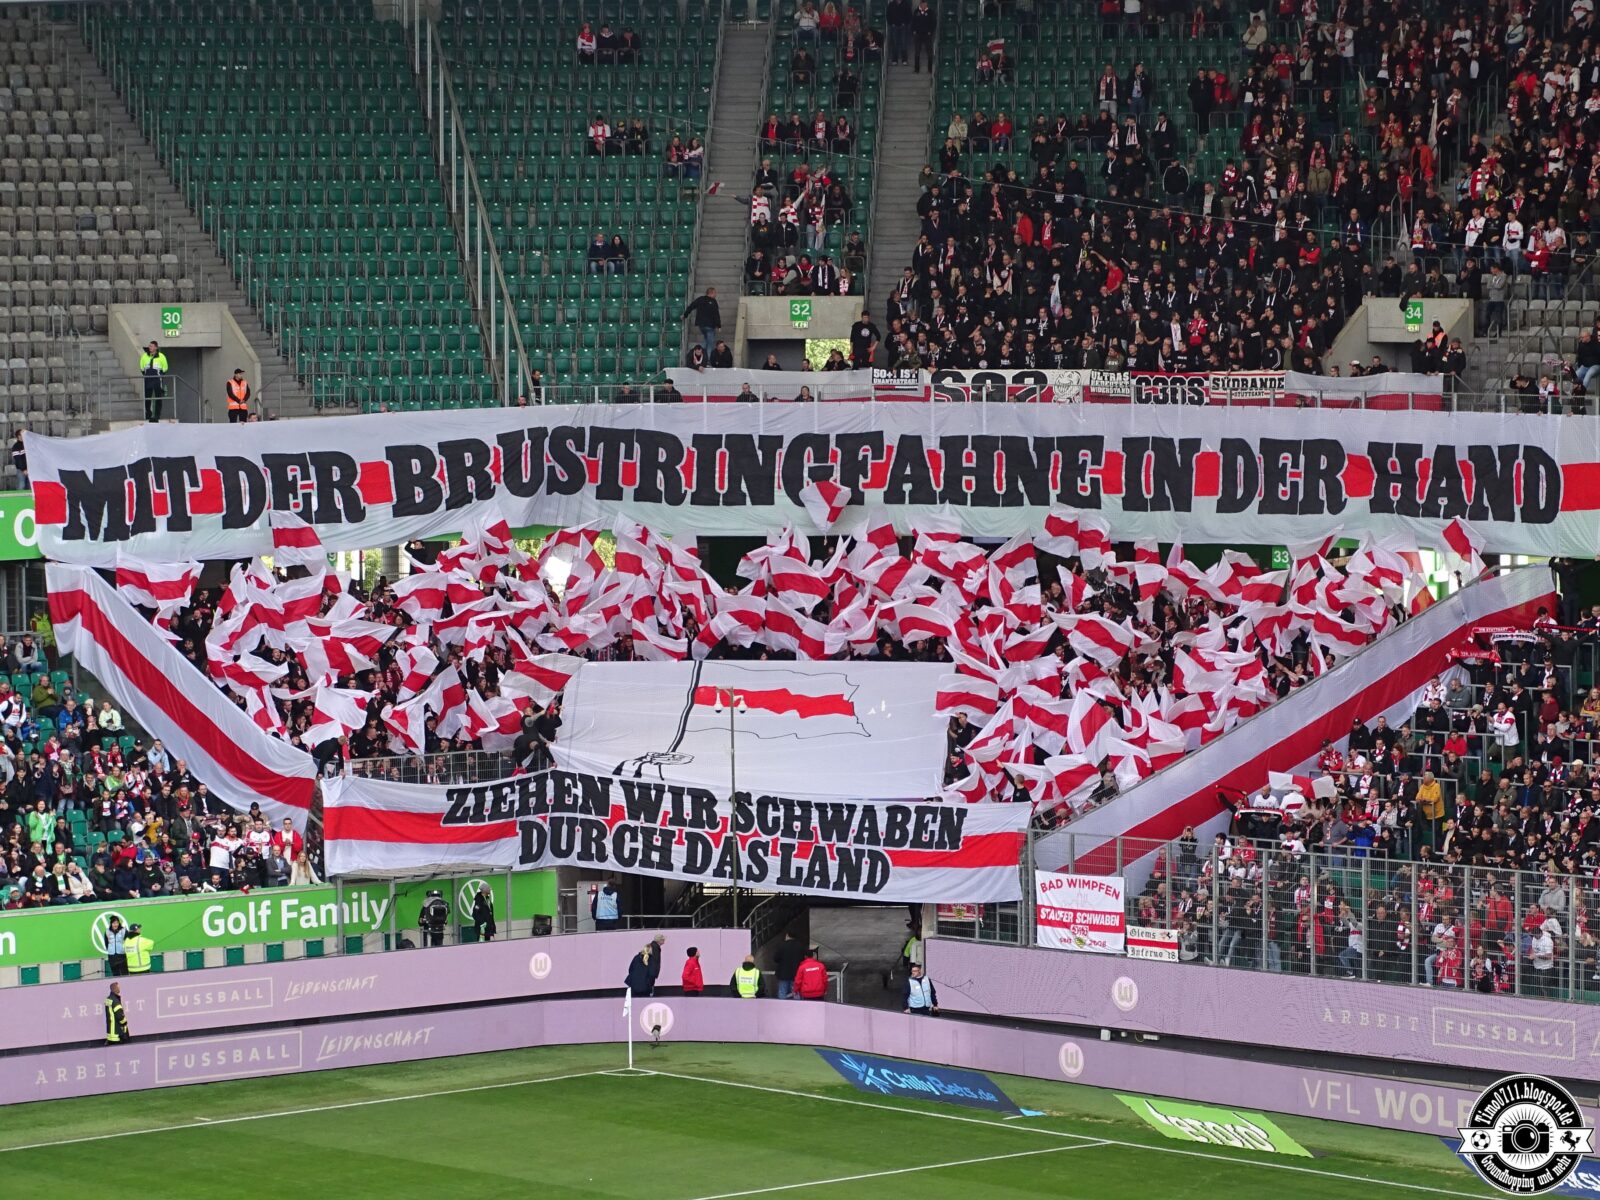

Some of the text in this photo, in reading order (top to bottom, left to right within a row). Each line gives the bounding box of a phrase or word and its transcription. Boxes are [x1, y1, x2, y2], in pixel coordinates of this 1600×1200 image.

[163, 312, 181, 325] 30
[791, 303, 810, 316] 32
[1406, 307, 1422, 319] 34
[1091, 370, 1130, 382] ULTRAS
[1211, 376, 1285, 391] SÜDBANDE
[58, 425, 1562, 543] MIT DER BRUSTRINGFAHNE IN DER HAND
[1273, 550, 1290, 563] 33
[441, 771, 969, 851] ZIEHEN WIR SCHWABEN
[518, 815, 891, 894] DURCH DAS LAND
[1040, 878, 1121, 900] BAD WIMPFEN
[202, 891, 389, 937] Golf Family
[1040, 908, 1120, 926] STAUFER SCHWABEN
[1130, 928, 1157, 939] Glems
[62, 1000, 145, 1018] ARBIT
[167, 987, 264, 1009] FUSSBALL
[1322, 1007, 1420, 1032] ARBEIT
[1444, 1019, 1564, 1047] FUSSBALL
[35, 1059, 141, 1085] ARBEIT
[168, 1044, 290, 1070] FUSSBALL
[880, 1067, 999, 1102] ChillyBets.de
[1302, 1077, 1474, 1129] VFL WOLF
